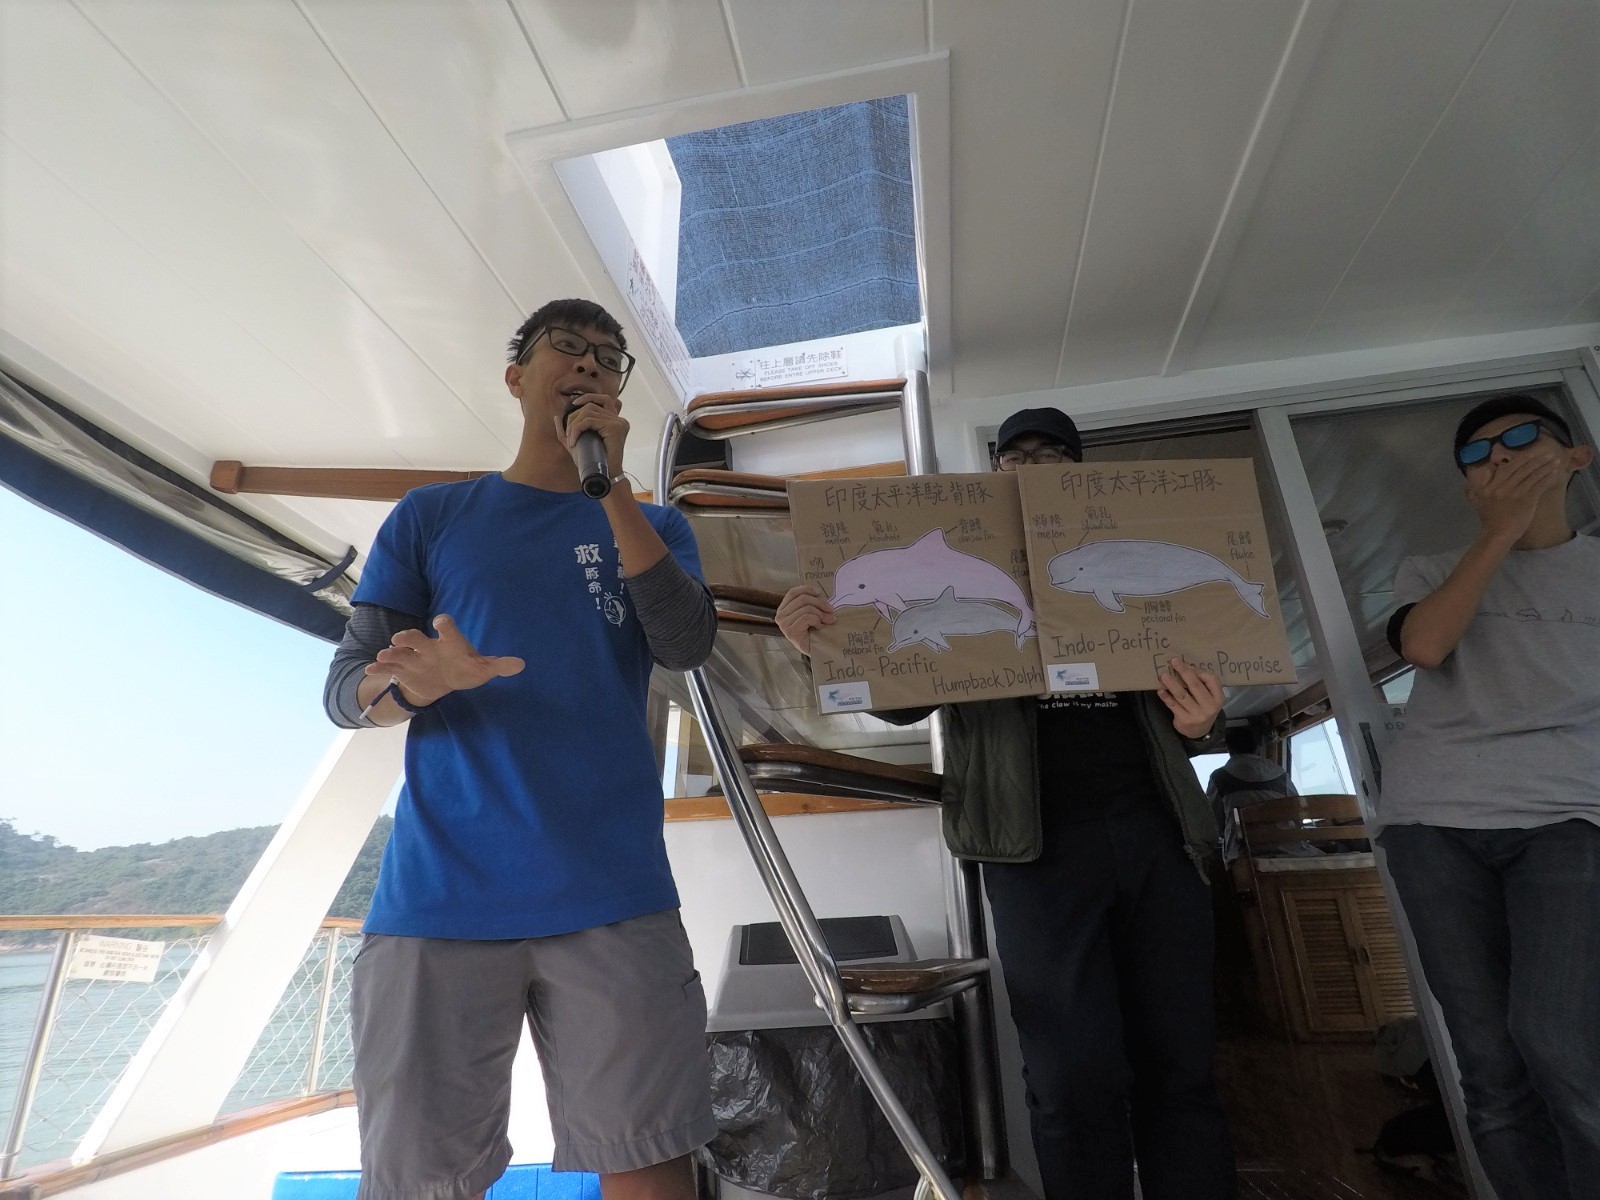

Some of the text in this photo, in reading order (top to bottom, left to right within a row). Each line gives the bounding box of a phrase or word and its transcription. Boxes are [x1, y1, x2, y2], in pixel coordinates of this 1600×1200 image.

[760, 374, 783, 382] BEFORE
[785, 371, 803, 379] ENTRE
[764, 368, 785, 376] PLEASE
[1060, 469, 1223, 499] 印度太平洋江豚
[825, 482, 993, 512] 印度太平洋駝背豚
[1082, 519, 1119, 531] blowhole
[1037, 529, 1066, 540] melon
[1231, 547, 1256, 560] fluke
[1141, 613, 1187, 628] pectoral fin
[1051, 629, 1171, 659] Indo-Pacific
[1217, 650, 1283, 680] Porpoise
[932, 665, 1043, 696] Humpback Dolph
[1051, 701, 1070, 709] claw
[1081, 702, 1092, 710] my
